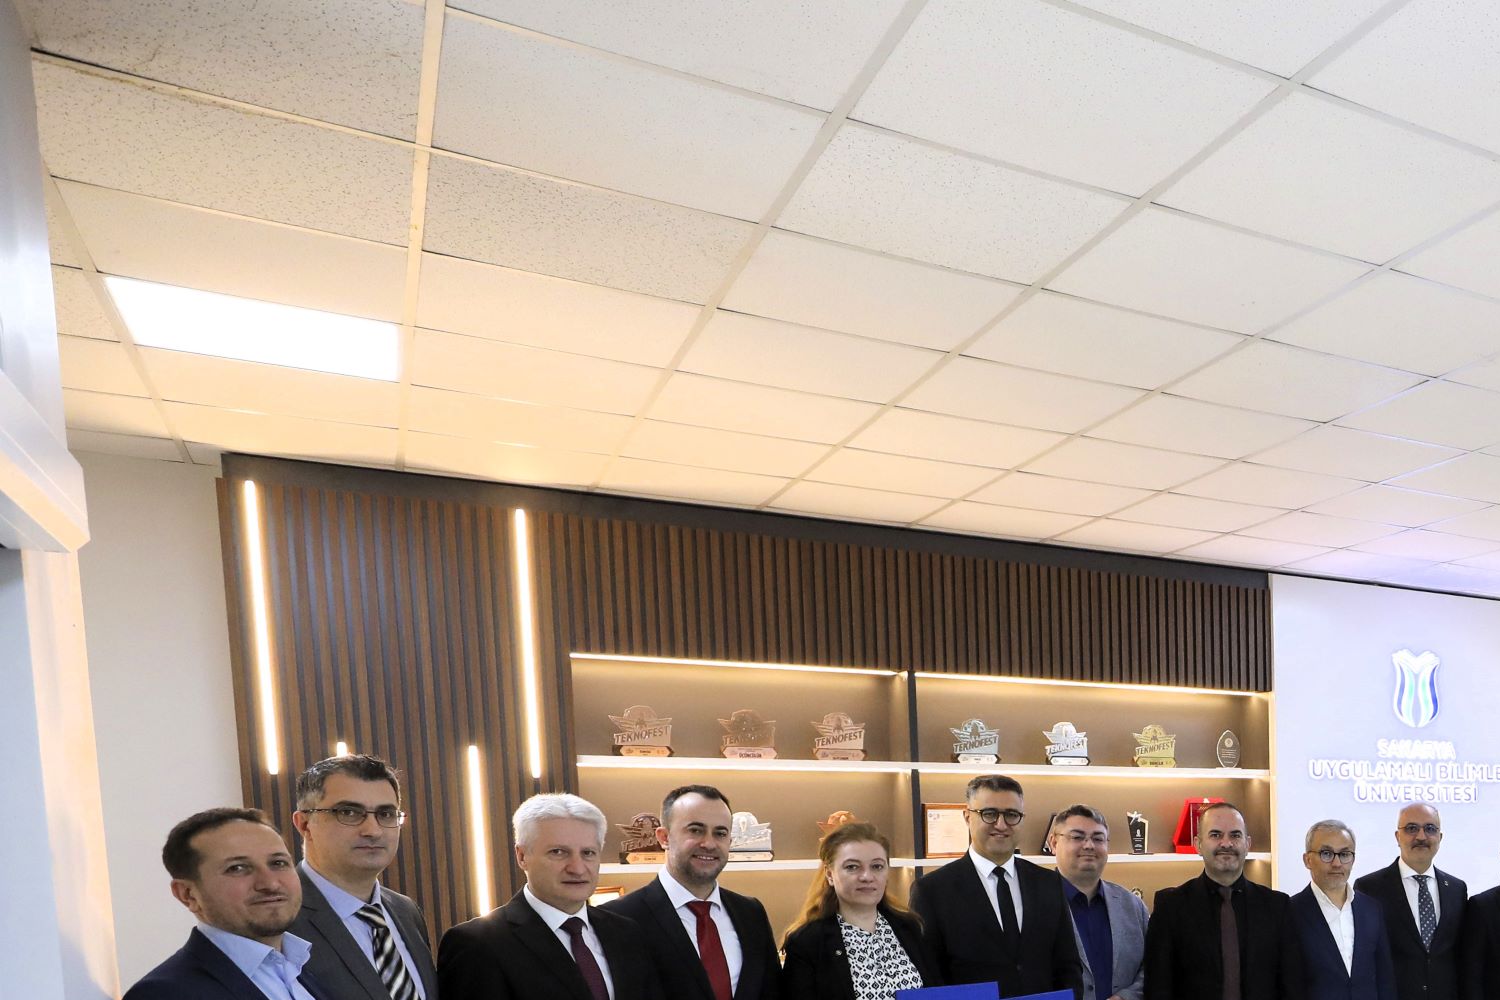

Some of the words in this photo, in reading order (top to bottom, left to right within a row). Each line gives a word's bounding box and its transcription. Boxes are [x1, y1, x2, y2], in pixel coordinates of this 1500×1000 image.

[615, 725, 669, 744] TEKNOFEST
[816, 731, 863, 747] TEKNOFEST
[953, 735, 998, 753] TEKNOFEST
[1136, 741, 1174, 756] TEKNOFEST
[1311, 761, 1432, 779] UYGULAMALI
[1357, 782, 1478, 802] ÜNİVERSİTESİ
